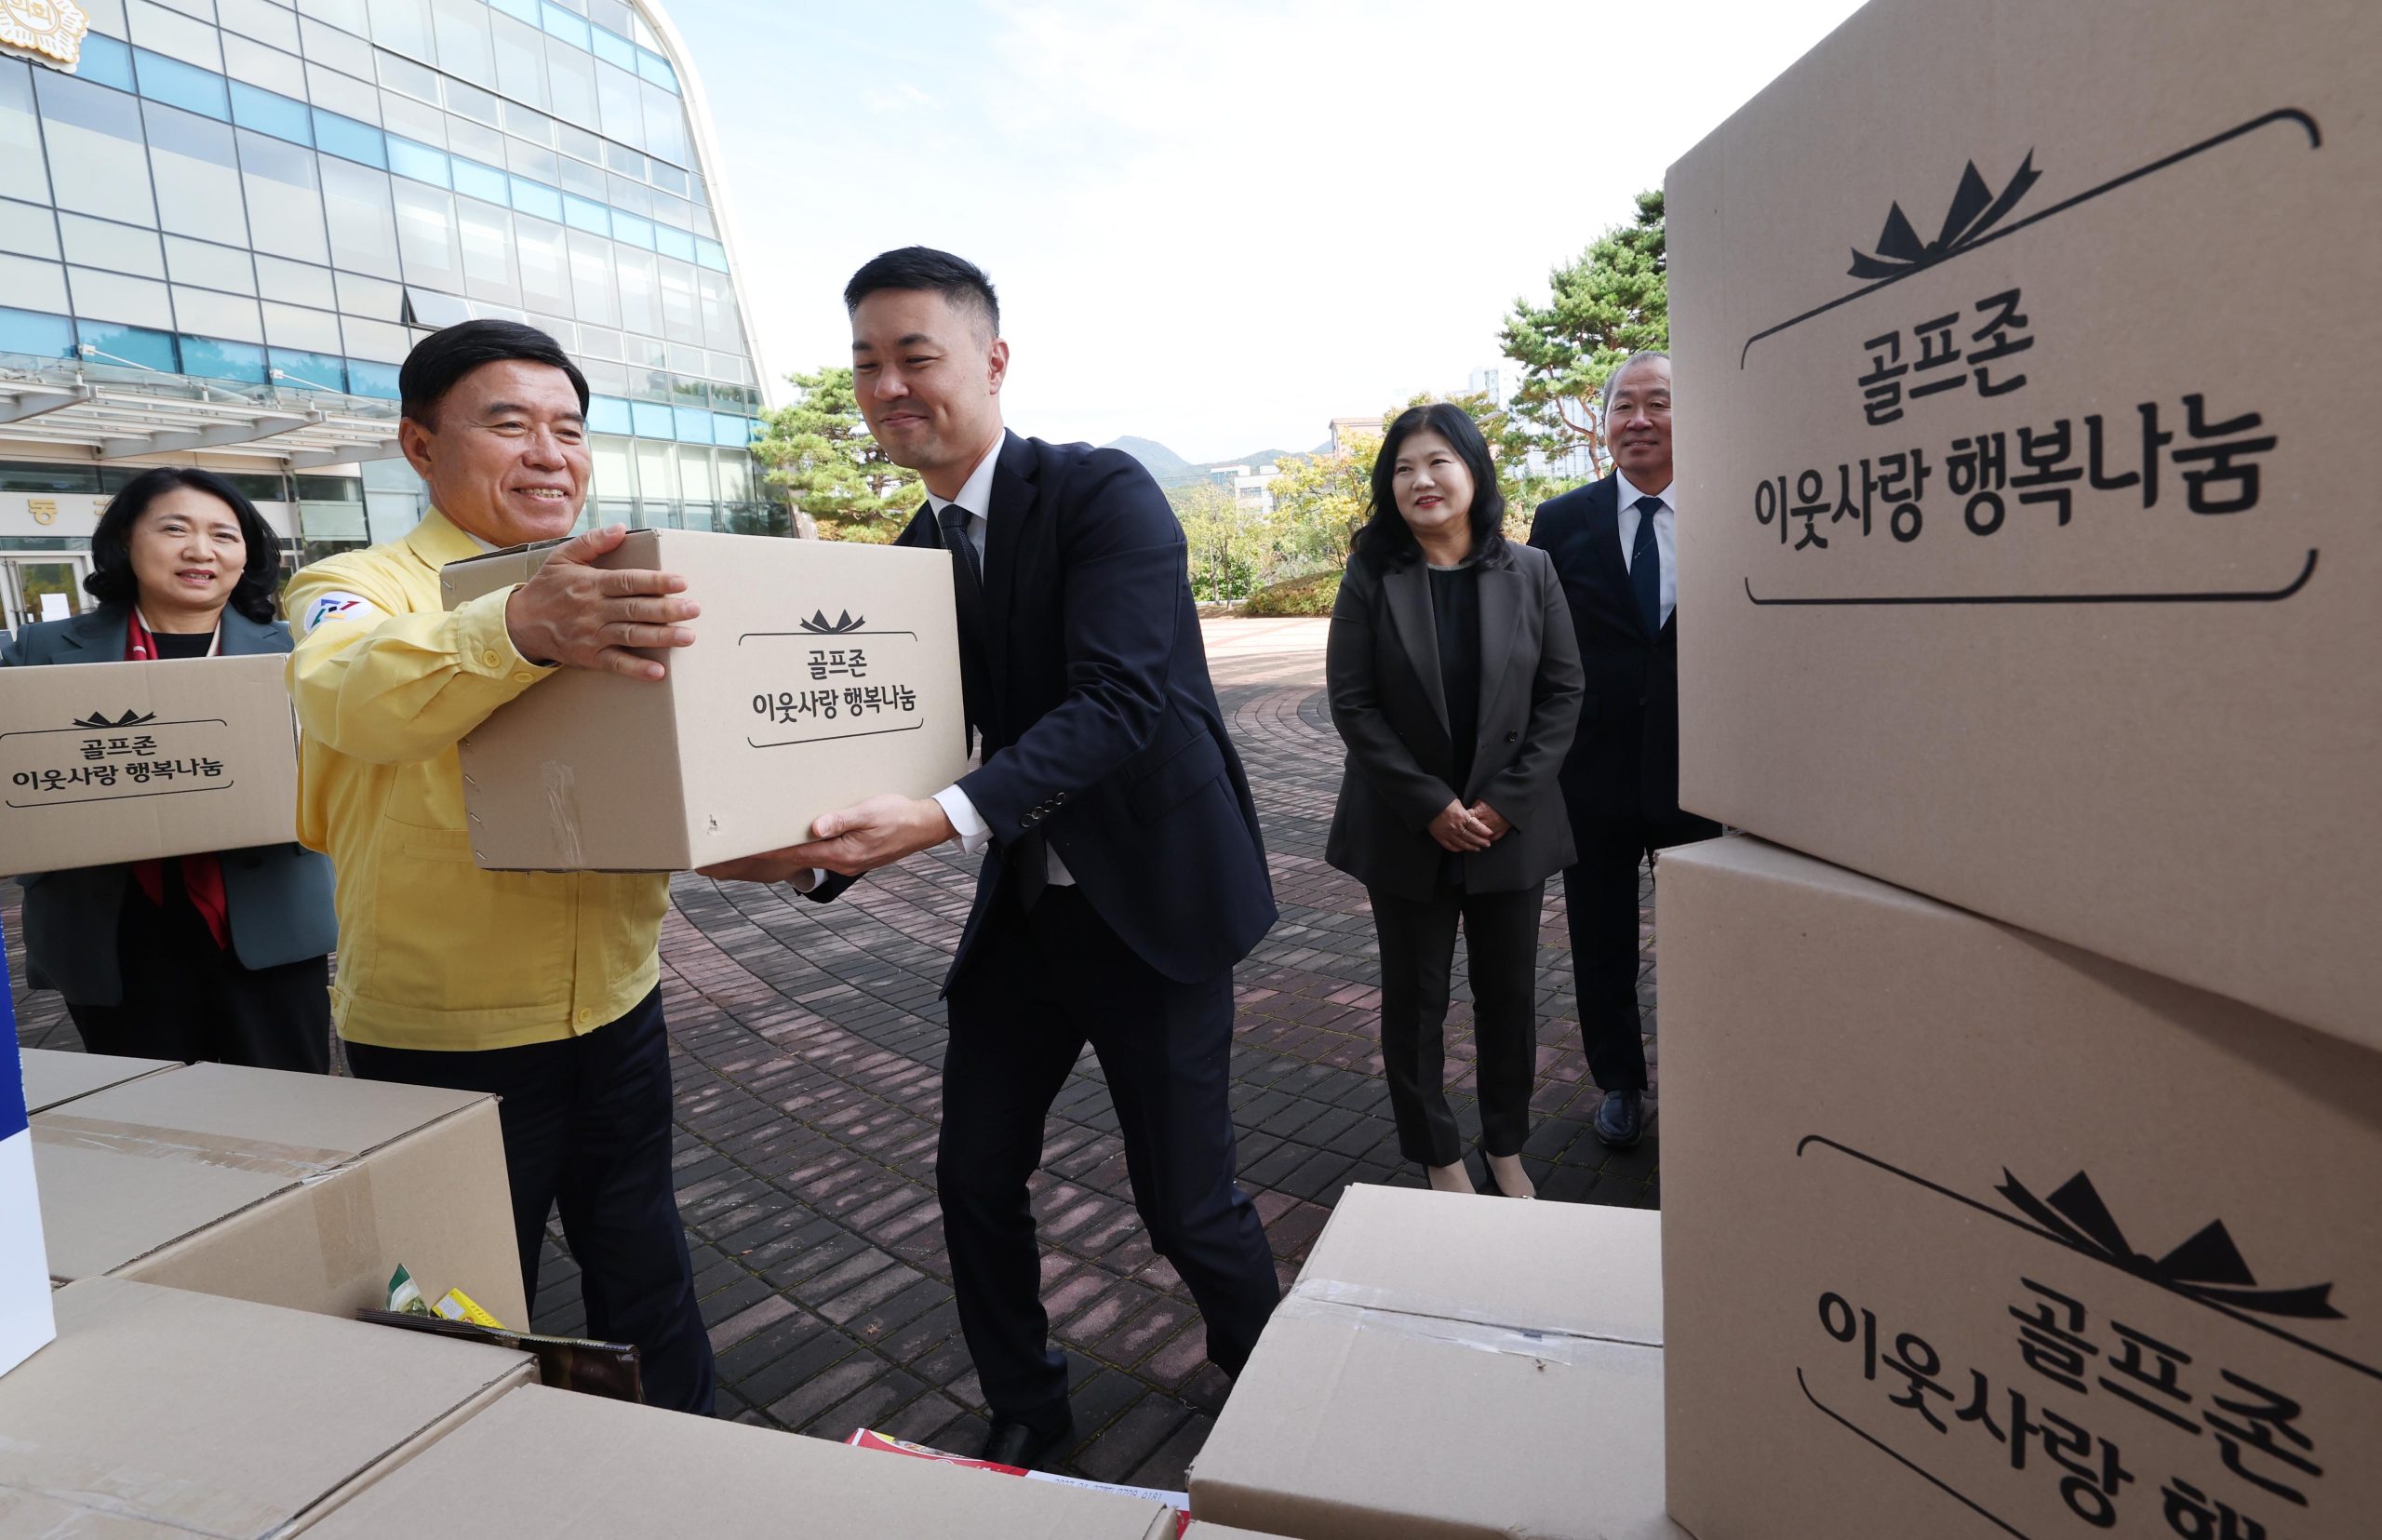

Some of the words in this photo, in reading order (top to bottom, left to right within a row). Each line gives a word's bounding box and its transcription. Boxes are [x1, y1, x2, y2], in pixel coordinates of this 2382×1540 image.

[1858, 288, 2035, 427] 골프존
[1755, 449, 1933, 551] 이웃사랑
[1946, 393, 2279, 537] 행복나눔
[752, 689, 839, 724] 이웃사랑
[843, 684, 917, 716] 행복나눔
[807, 649, 867, 680] 골프존
[12, 764, 119, 792] 이웃사랑
[125, 757, 224, 783] 행복나눔
[79, 735, 158, 760] 골프존
[1817, 1291, 2135, 1529] 이웃사랑
[2008, 1277, 2324, 1508] 골프존
